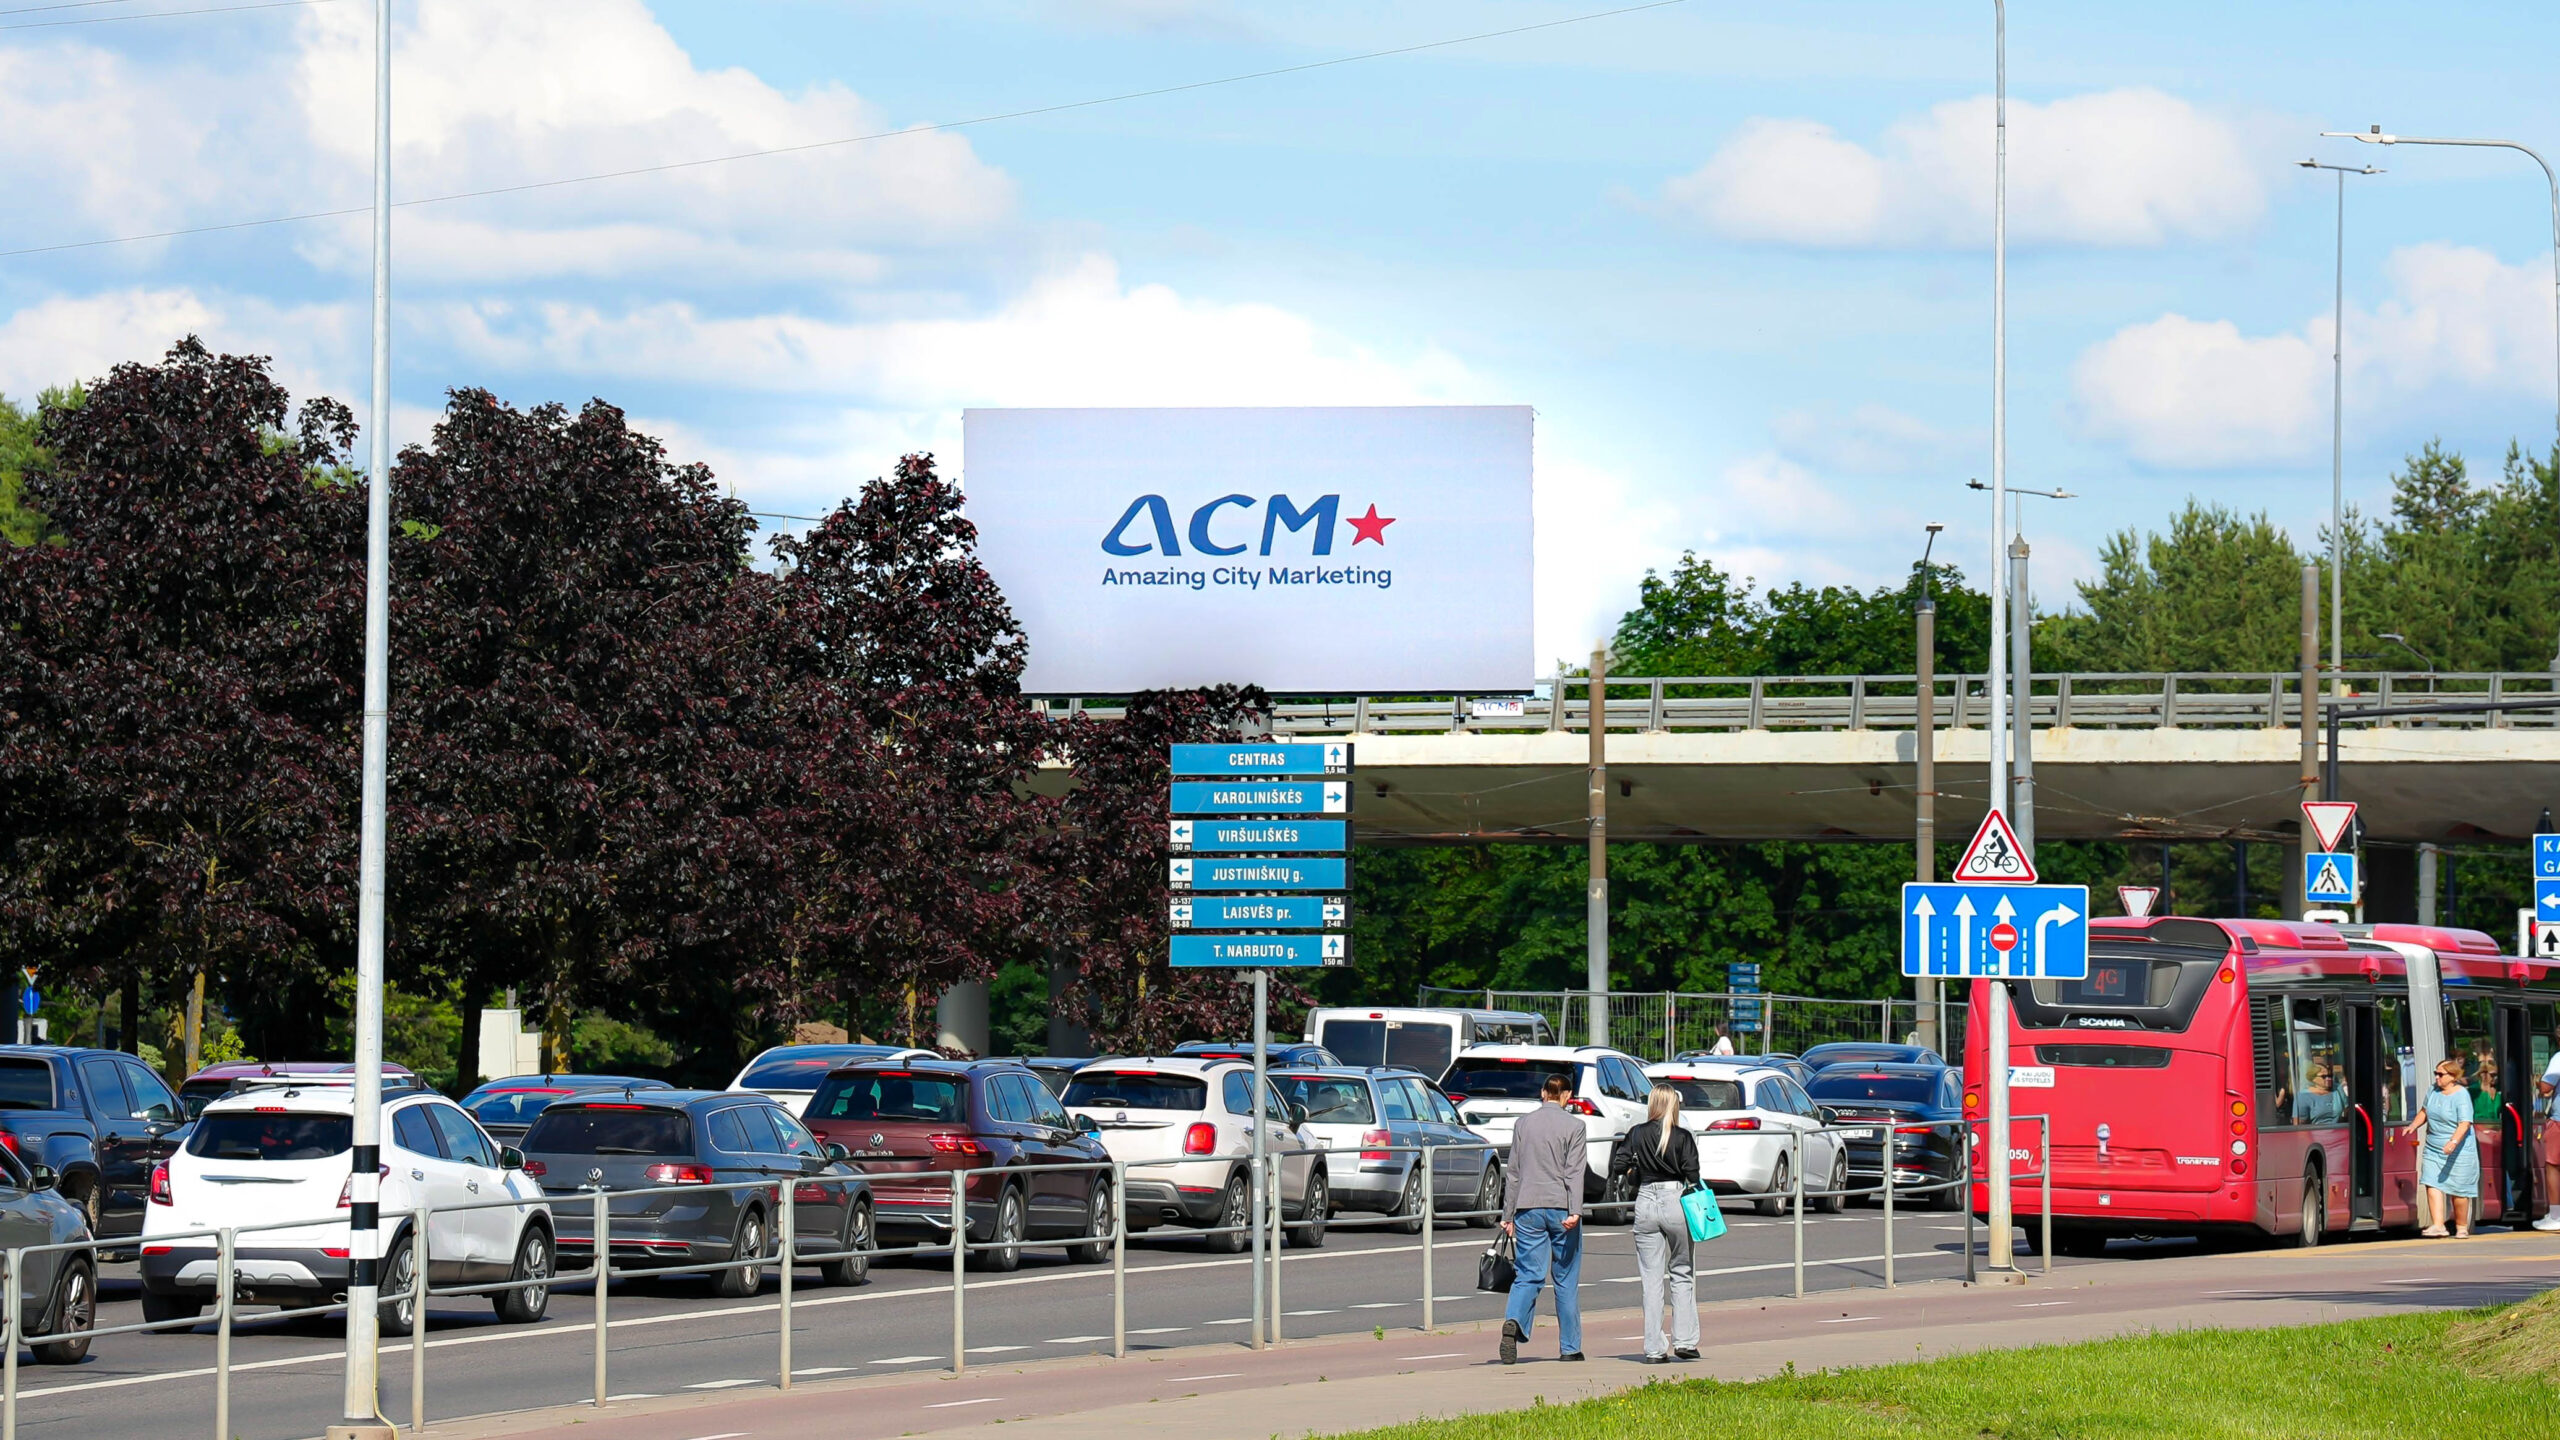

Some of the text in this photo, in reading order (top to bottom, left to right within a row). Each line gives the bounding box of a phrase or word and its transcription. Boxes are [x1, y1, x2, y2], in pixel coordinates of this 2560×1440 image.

[1101, 494, 1340, 556] ACM
[1102, 566, 1391, 590] Amazing City Marketing
[1229, 753, 1285, 766] CENTRAS
[1213, 789, 1303, 804] KAROLINIŠKĖS
[1218, 827, 1298, 842] VIRŠULIŠKĖS
[1212, 866, 1303, 883] JUSTINIŠKIŲ g.
[1223, 904, 1292, 921] LAISVĖS pr.
[1213, 945, 1298, 959] T. NARBUTO g.
[2079, 1017, 2126, 1028] SCANIA
